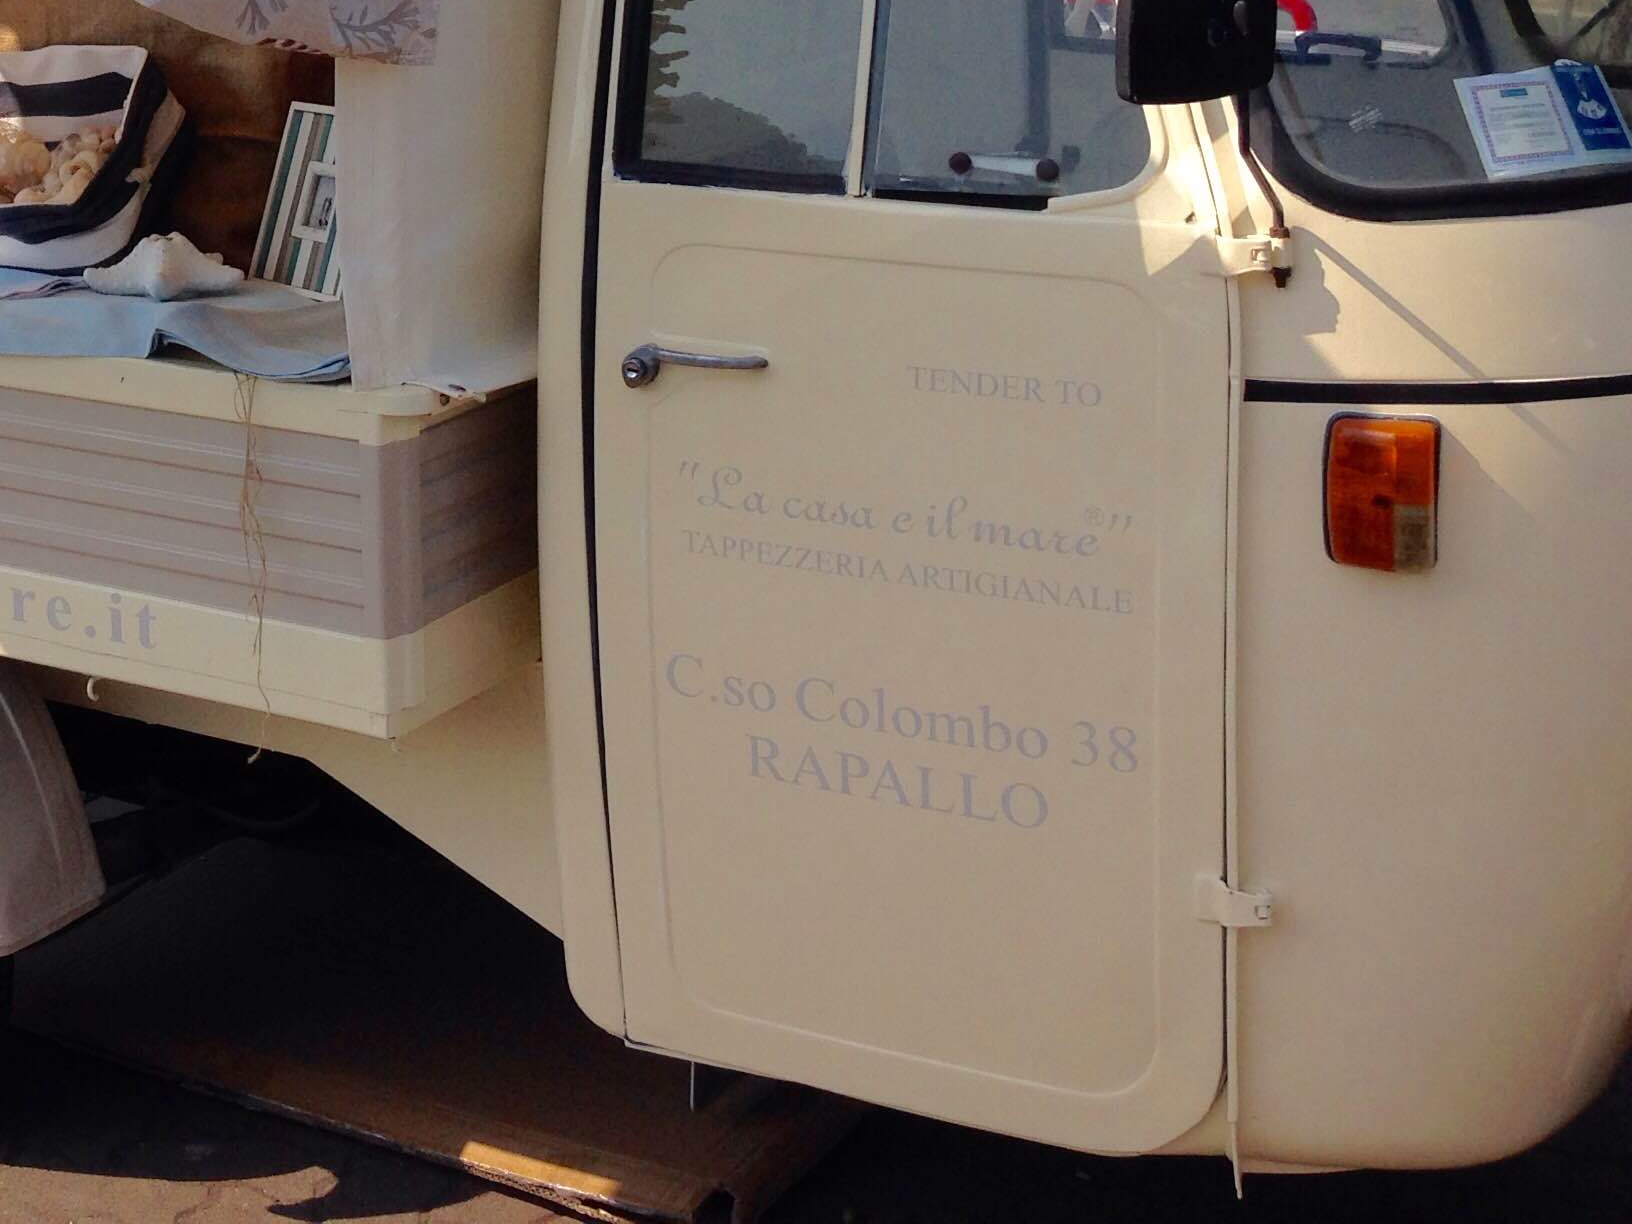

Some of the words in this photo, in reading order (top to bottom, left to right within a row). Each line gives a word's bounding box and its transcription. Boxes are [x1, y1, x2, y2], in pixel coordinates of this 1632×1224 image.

[907, 365, 1045, 403] TENDER
[1056, 378, 1102, 407] TO
[783, 497, 878, 531] casa
[892, 511, 914, 534] e
[927, 495, 968, 540] il
[682, 529, 889, 584] TAPPEZZERIA
[896, 562, 1134, 615] ARTIGIANALE
[666, 653, 777, 713] C.so
[795, 677, 1049, 760] Colombo
[1071, 720, 1139, 773] 38
[746, 733, 1049, 829] RAPALLO
